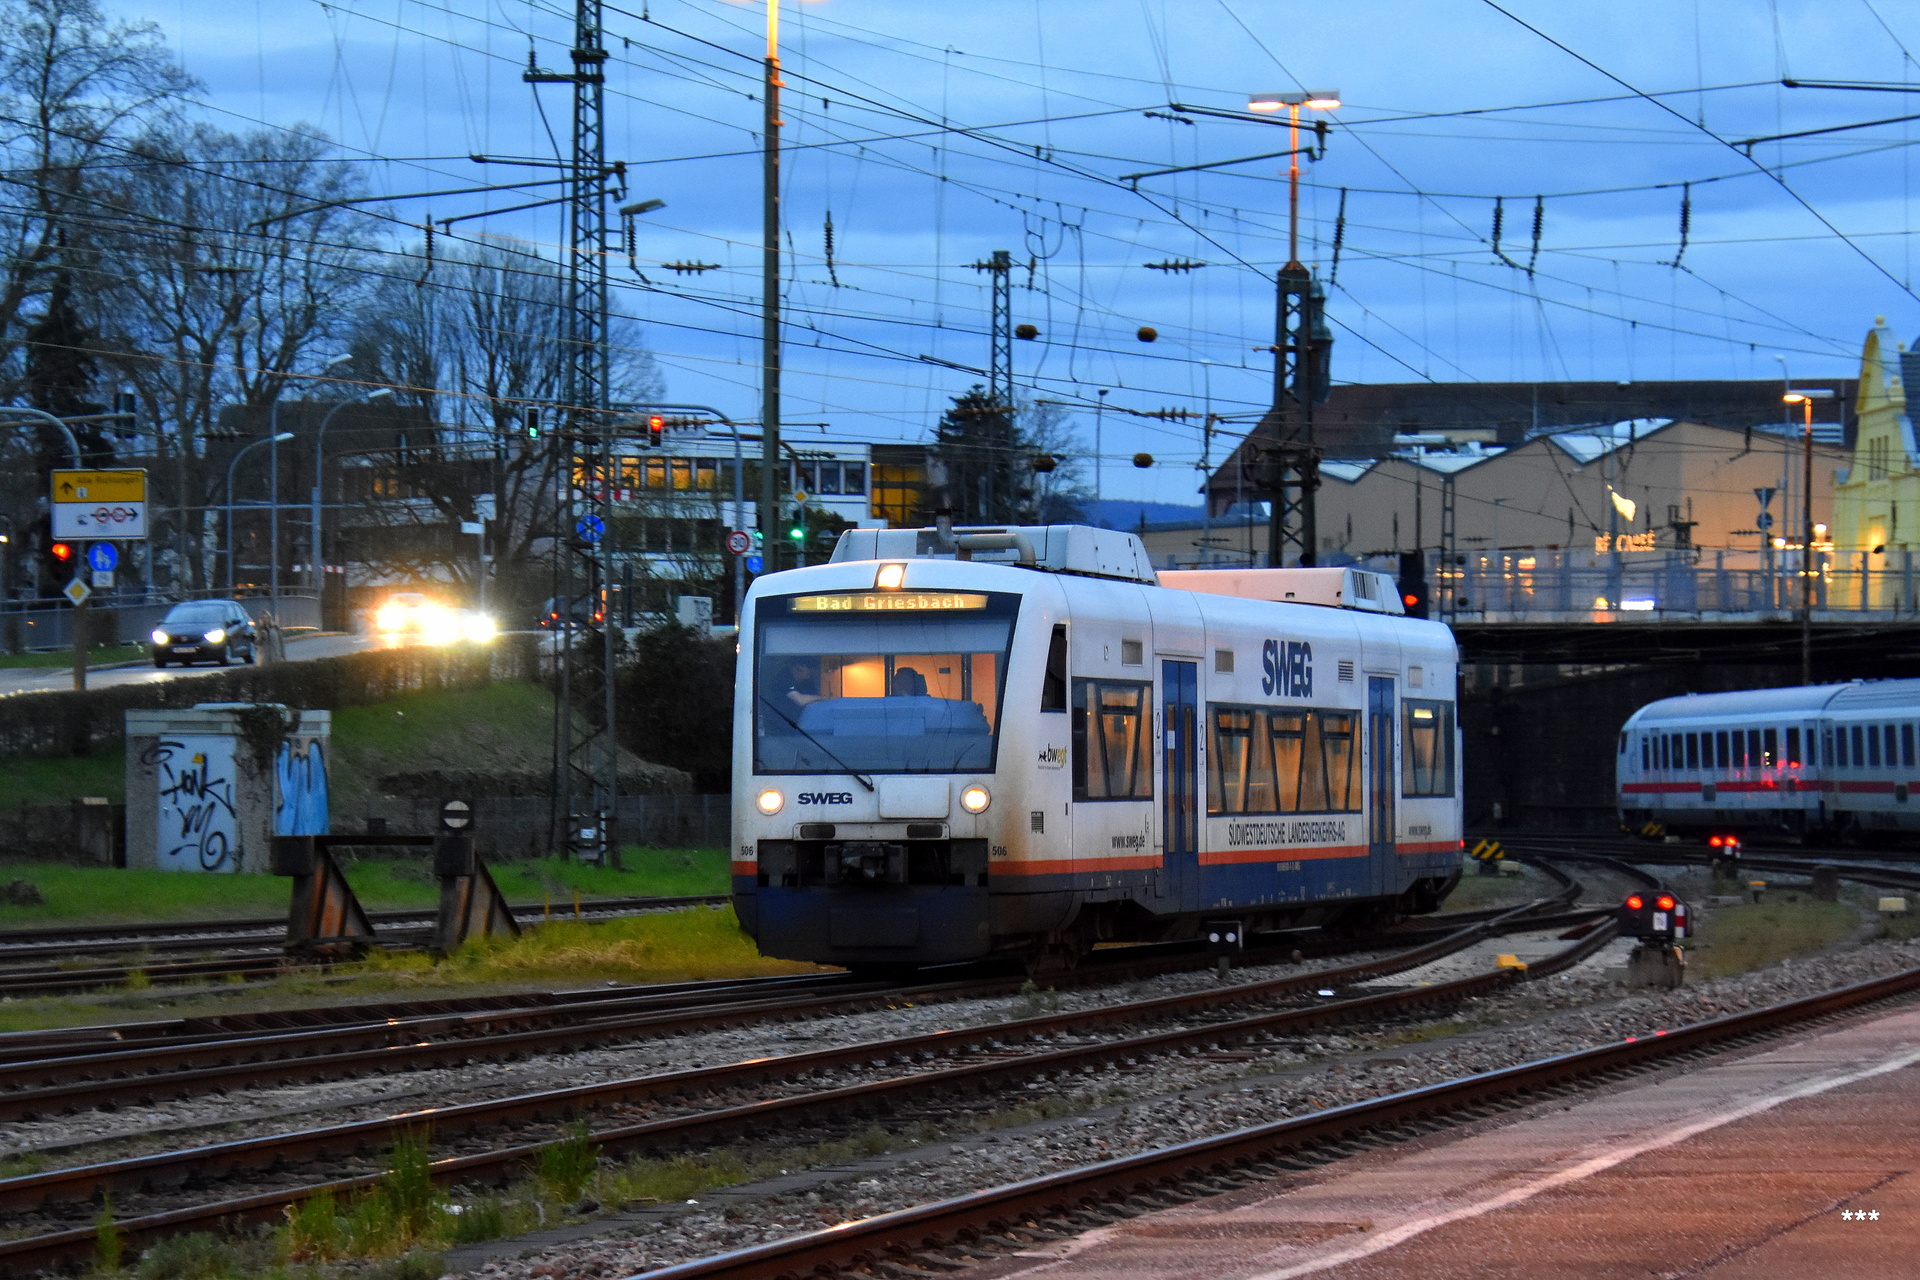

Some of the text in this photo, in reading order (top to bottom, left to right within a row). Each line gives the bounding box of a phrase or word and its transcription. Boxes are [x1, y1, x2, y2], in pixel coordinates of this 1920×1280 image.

[732, 536, 746, 549] 30
[816, 594, 965, 610] Bad Griesbach
[1261, 638, 1313, 699] SWEG
[1156, 711, 1161, 740] 2
[1047, 742, 1068, 769] bwegt
[797, 792, 853, 805] SWEG
[1111, 830, 1146, 853] www.sweg.de
[1228, 818, 1346, 846] SÜDWESTDEUTSCHE LANDESVERKEHRS-AG
[740, 846, 754, 856] 506
[992, 846, 1008, 856] 506
